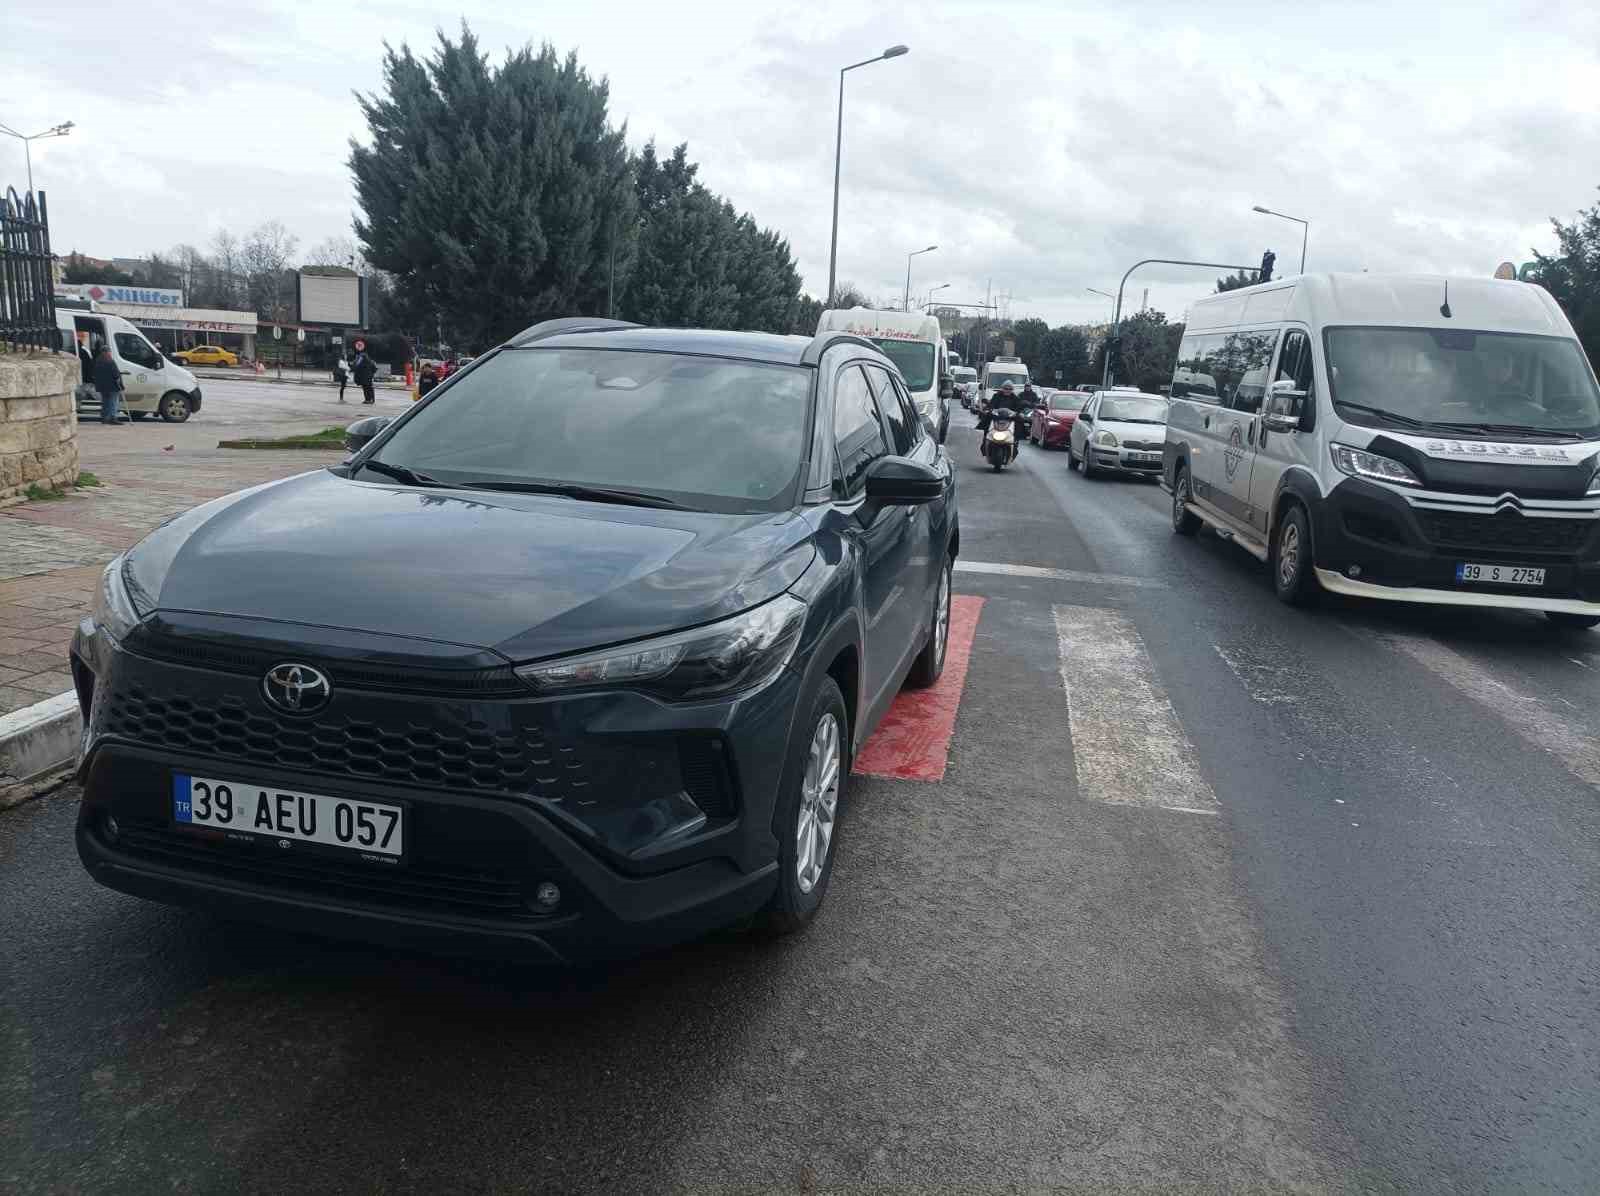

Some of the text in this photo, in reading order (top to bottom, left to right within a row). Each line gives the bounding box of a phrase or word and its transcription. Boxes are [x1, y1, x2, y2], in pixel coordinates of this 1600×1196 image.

[107, 287, 179, 305] Nilüfer
[1464, 565, 1480, 579] 39
[1492, 567, 1500, 580] S
[1511, 568, 1543, 584] 2754
[176, 782, 399, 848] TR 39 AEU 057
